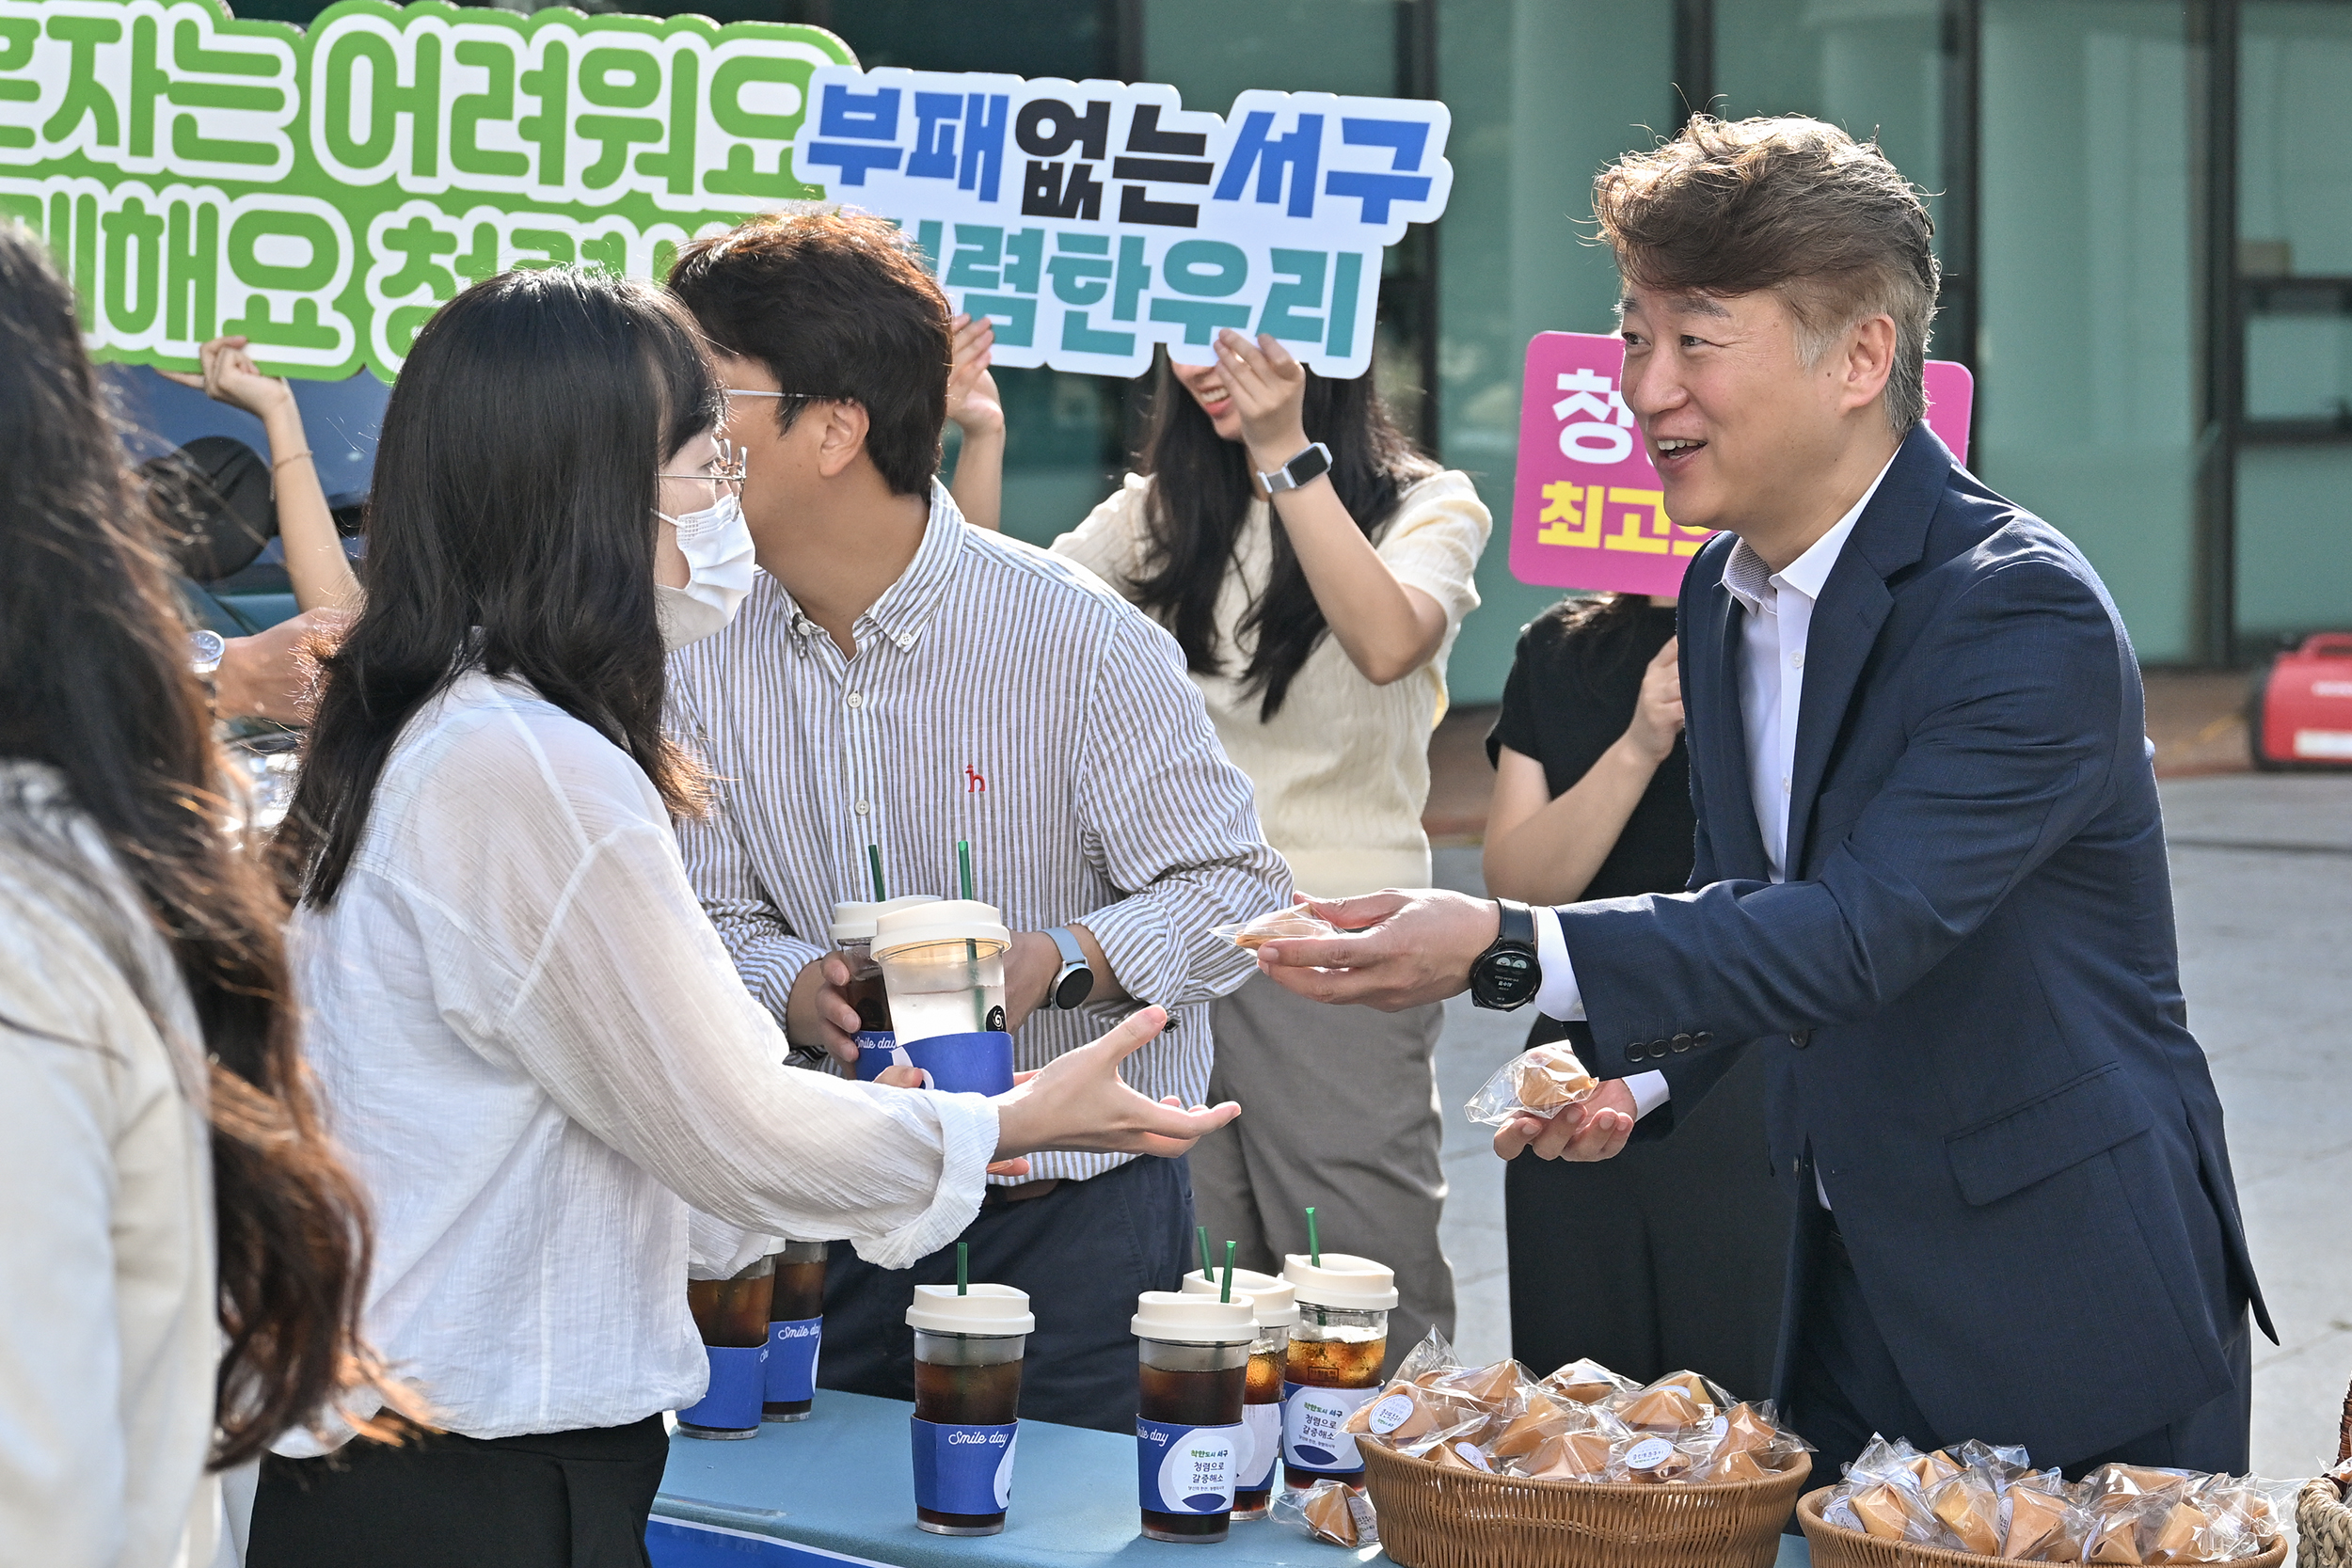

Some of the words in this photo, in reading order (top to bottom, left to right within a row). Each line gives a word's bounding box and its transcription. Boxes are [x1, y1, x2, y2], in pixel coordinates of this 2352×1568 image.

[325, 31, 826, 201] 어려워요
[777, 1326, 809, 1340] Smile
[1305, 1414, 1337, 1430] 청렴으로
[948, 1431, 987, 1445] Smile
[988, 1431, 1009, 1448] day
[1150, 1429, 1168, 1447] day
[1302, 1424, 1335, 1440] 갈증해소
[1193, 1461, 1225, 1472] 청렴으로
[1192, 1473, 1224, 1484] 갈증해소
